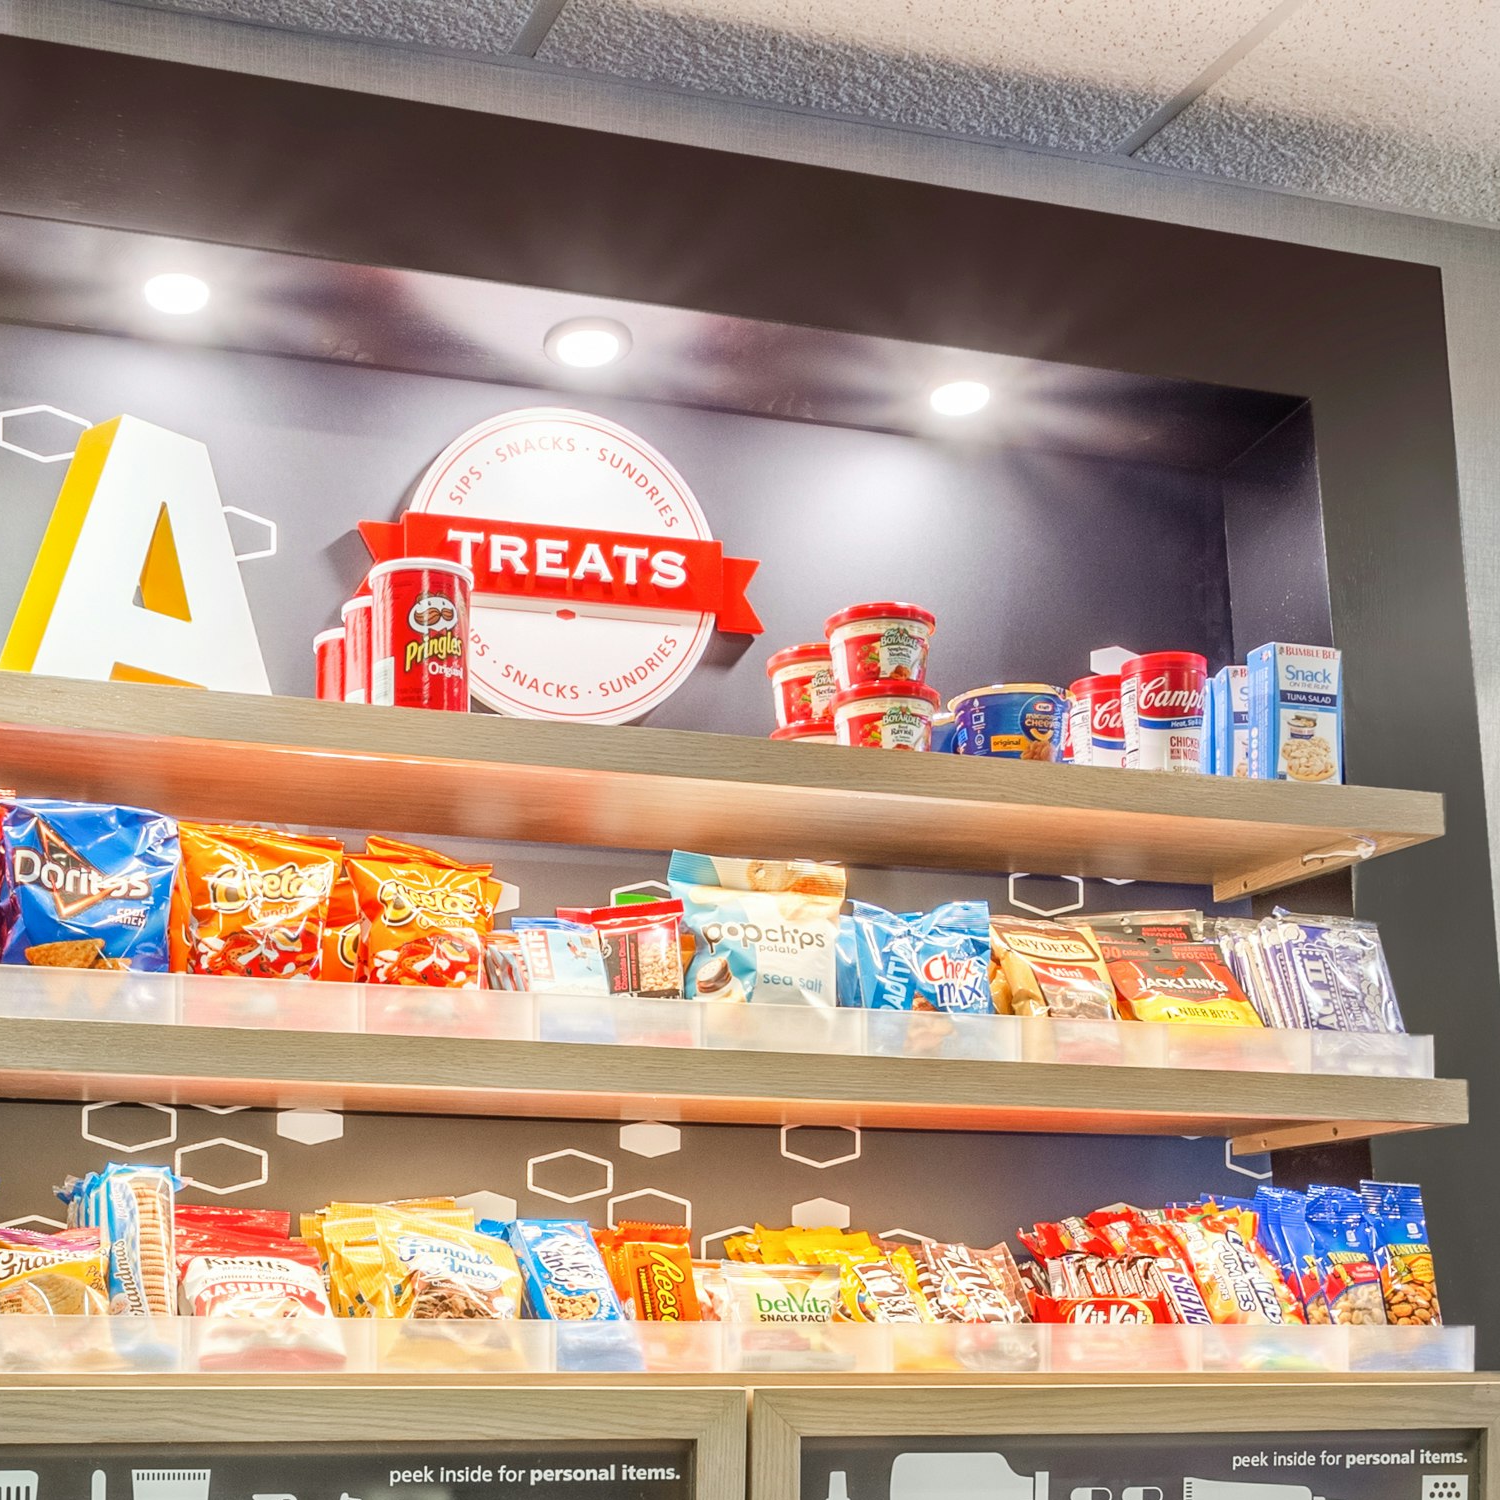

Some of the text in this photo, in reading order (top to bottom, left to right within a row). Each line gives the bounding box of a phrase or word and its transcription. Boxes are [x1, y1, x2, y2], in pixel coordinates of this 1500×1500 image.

[449, 436, 679, 529] SIPS SNACKS SUNDRIES
[447, 528, 687, 589] TREATS
[405, 631, 462, 672] Pringles
[1286, 645, 1338, 660] BUMBLE BEE
[501, 634, 678, 700] SNACKS SUNDRIES
[1285, 664, 1331, 684] Snack
[1287, 693, 1331, 704] TUNA SALAD
[992, 738, 1021, 747] original
[1170, 736, 1199, 748] CHICKE
[14, 849, 150, 897] Doritos
[380, 881, 478, 924] Cheetos
[702, 923, 825, 954] popchips
[759, 943, 798, 955] potato
[1008, 936, 1085, 954] SNYDER'S
[923, 953, 977, 982] Chex
[1048, 967, 1084, 979] Mini
[763, 973, 822, 994] sea salt
[1137, 977, 1180, 993] JACK
[1179, 978, 1229, 993] LINK'S
[649, 1250, 685, 1320] Rees
[756, 1289, 831, 1314] belVita
[760, 1313, 798, 1323] SNACK
[1232, 1449, 1468, 1470] peek inside for personal items.
[389, 1464, 681, 1486] peek inside for personal items.
